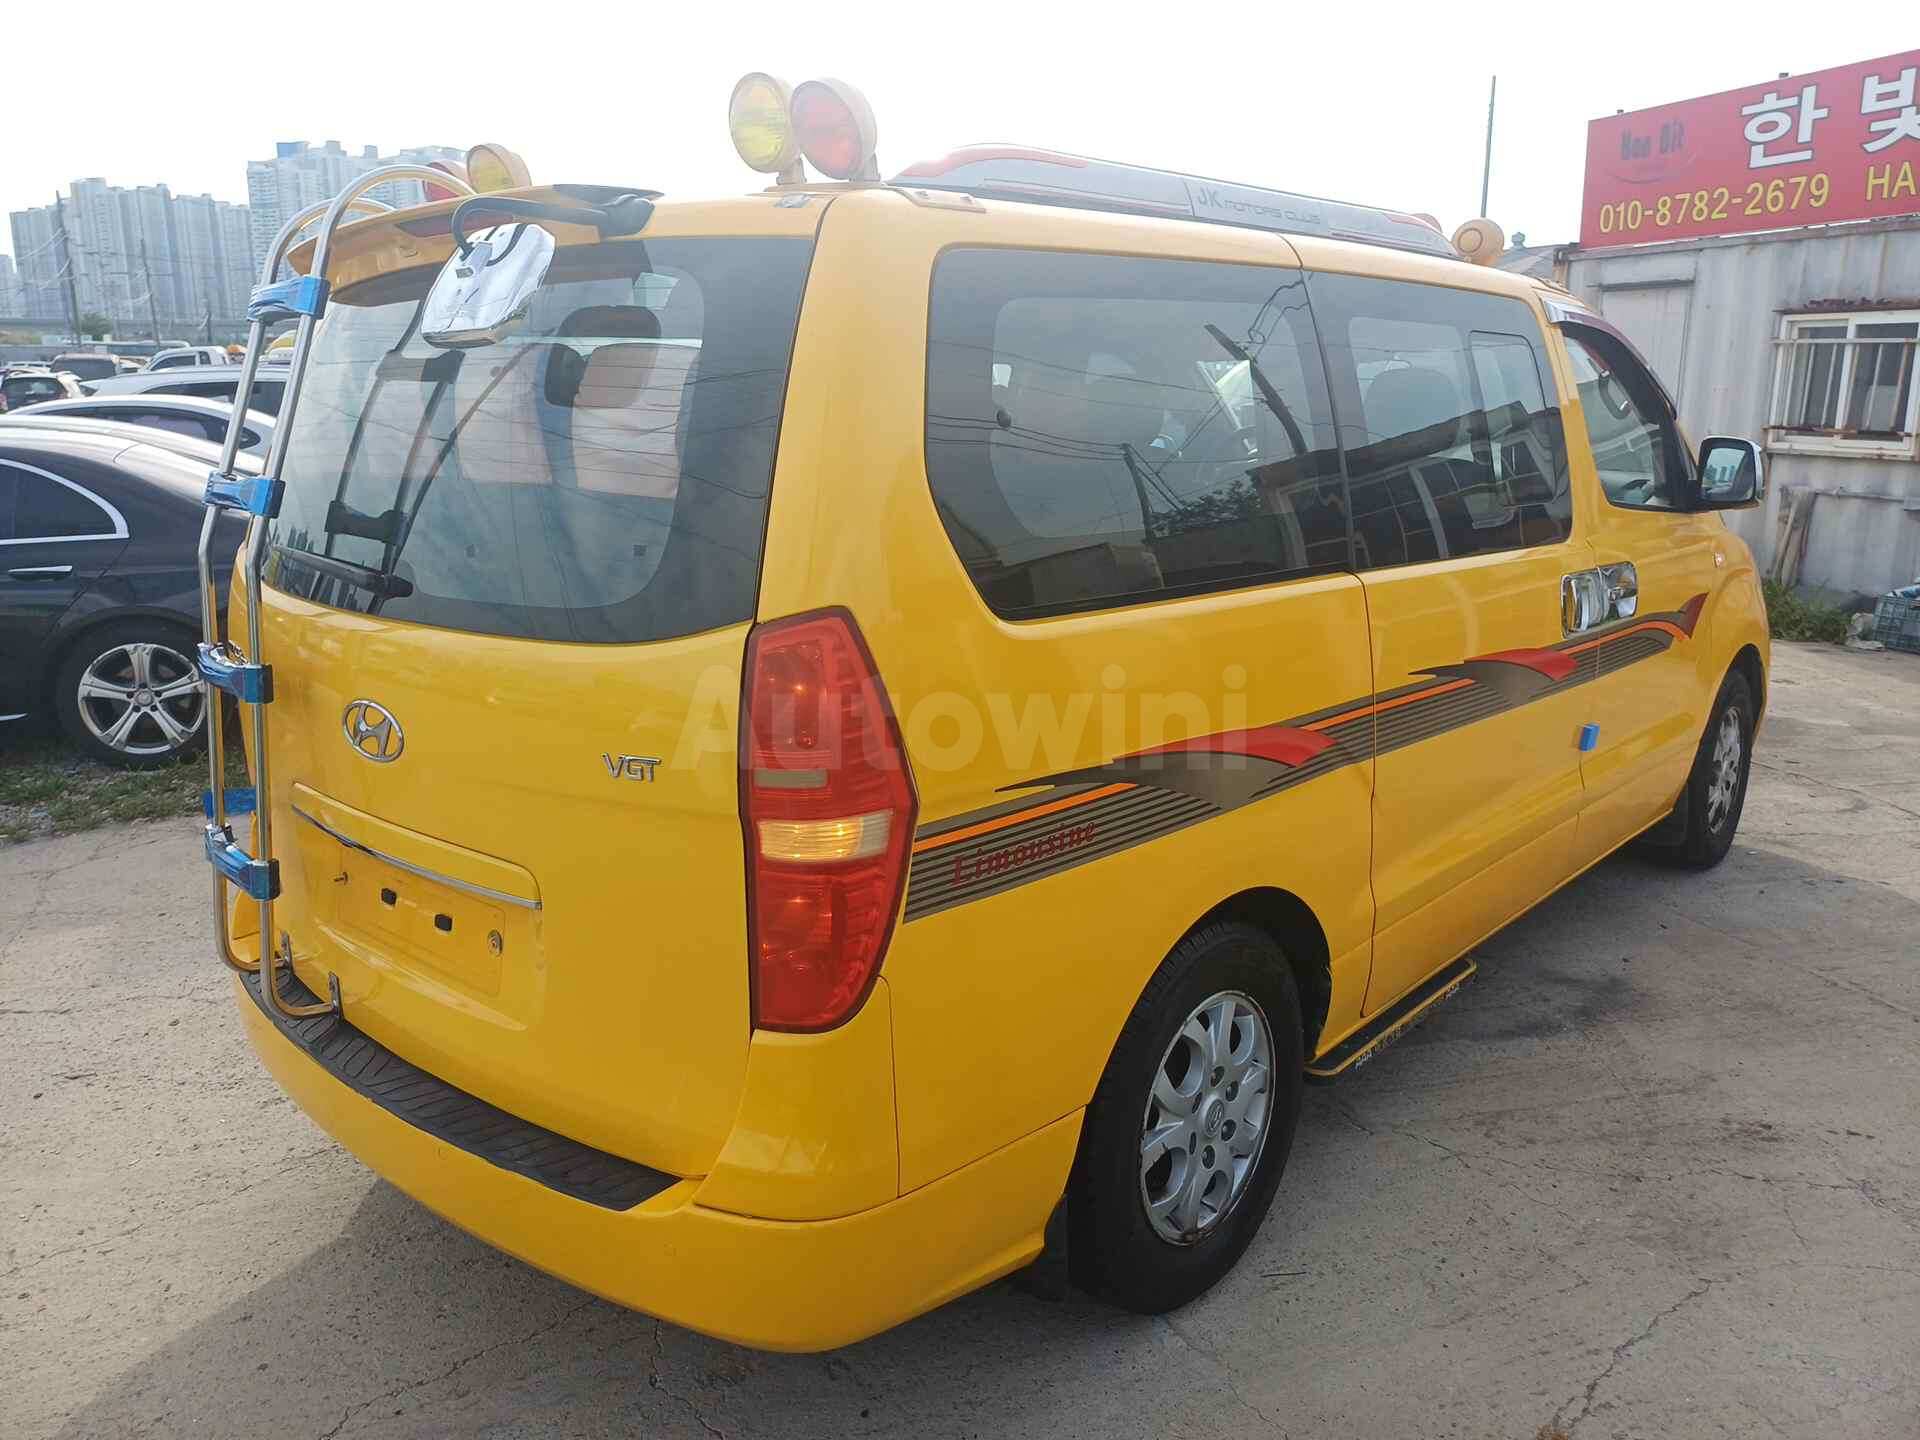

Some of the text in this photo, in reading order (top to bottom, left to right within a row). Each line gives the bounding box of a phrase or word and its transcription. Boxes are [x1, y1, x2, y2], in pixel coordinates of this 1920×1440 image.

[1598, 172, 1831, 234] 010-8782-2679
[600, 752, 662, 783] VGT
[951, 822, 1097, 886] Limousine
